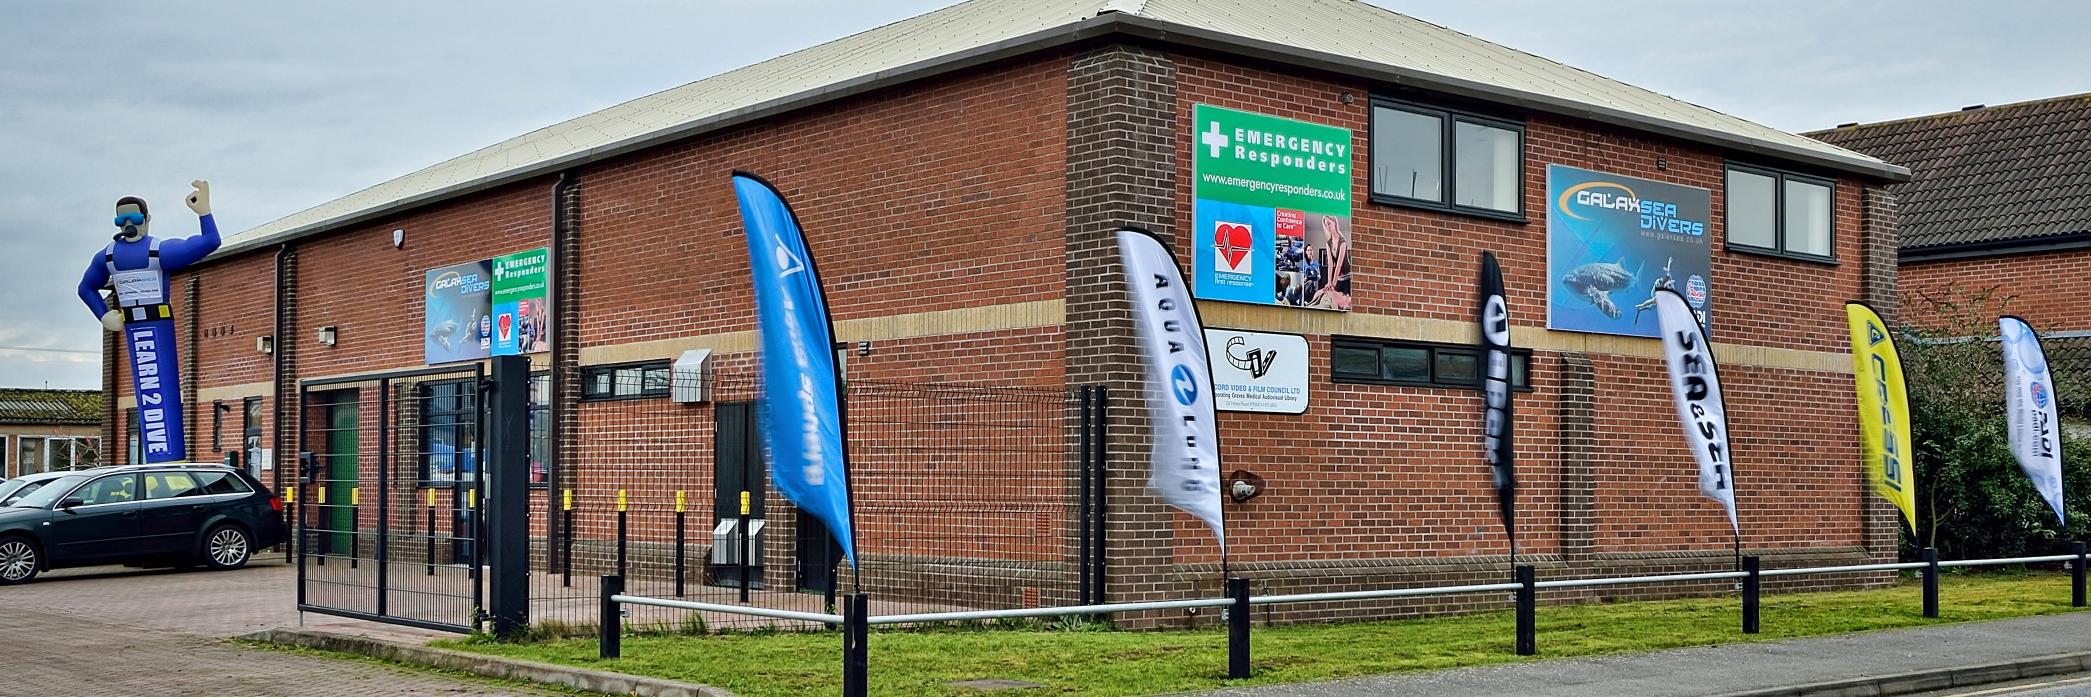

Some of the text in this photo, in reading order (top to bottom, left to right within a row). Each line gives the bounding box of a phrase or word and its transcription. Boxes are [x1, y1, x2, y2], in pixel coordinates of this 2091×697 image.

[1235, 128, 1345, 157] EMERGENCY
[1235, 145, 1345, 174] Responders
[1203, 173, 1345, 200] www.emergencyresponders.co.uk
[505, 254, 545, 270] EMERGENCY
[505, 265, 545, 279] Responders
[1215, 272, 1252, 282] EMERGENCY
[1153, 272, 1185, 354] AQUA
[133, 330, 168, 453] LEARN 2 DIVE
[1214, 383, 1229, 391] CORD
[1231, 384, 1247, 392] VIDEO
[1267, 386, 1289, 394] COUNCIL
[2039, 409, 2053, 459] PADI
